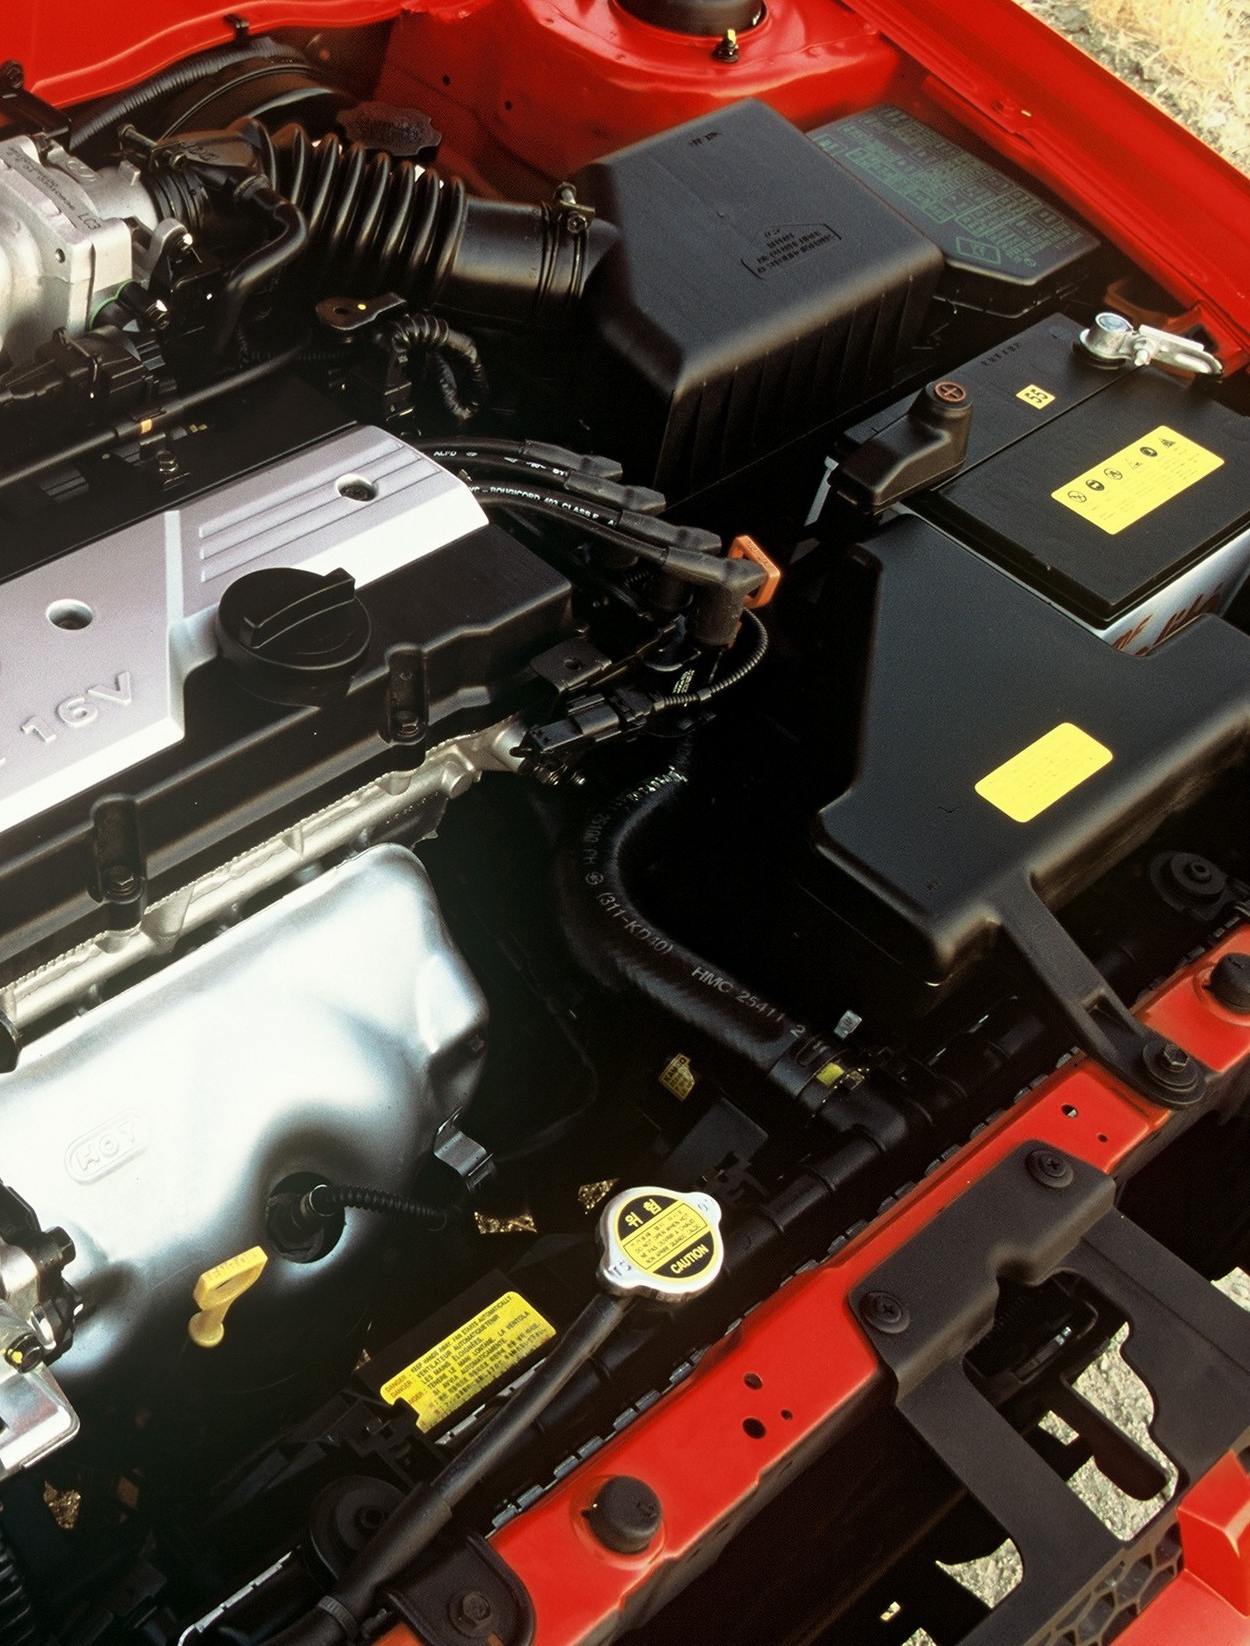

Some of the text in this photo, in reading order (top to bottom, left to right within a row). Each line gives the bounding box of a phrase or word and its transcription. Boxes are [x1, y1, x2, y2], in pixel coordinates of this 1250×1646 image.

[21, 671, 132, 743] 16V
[690, 965, 734, 993] HMC
[670, 1243, 710, 1274] CAUTION
[415, 1349, 453, 1379] VENTILATEUR
[432, 1360, 451, 1376] MAINS
